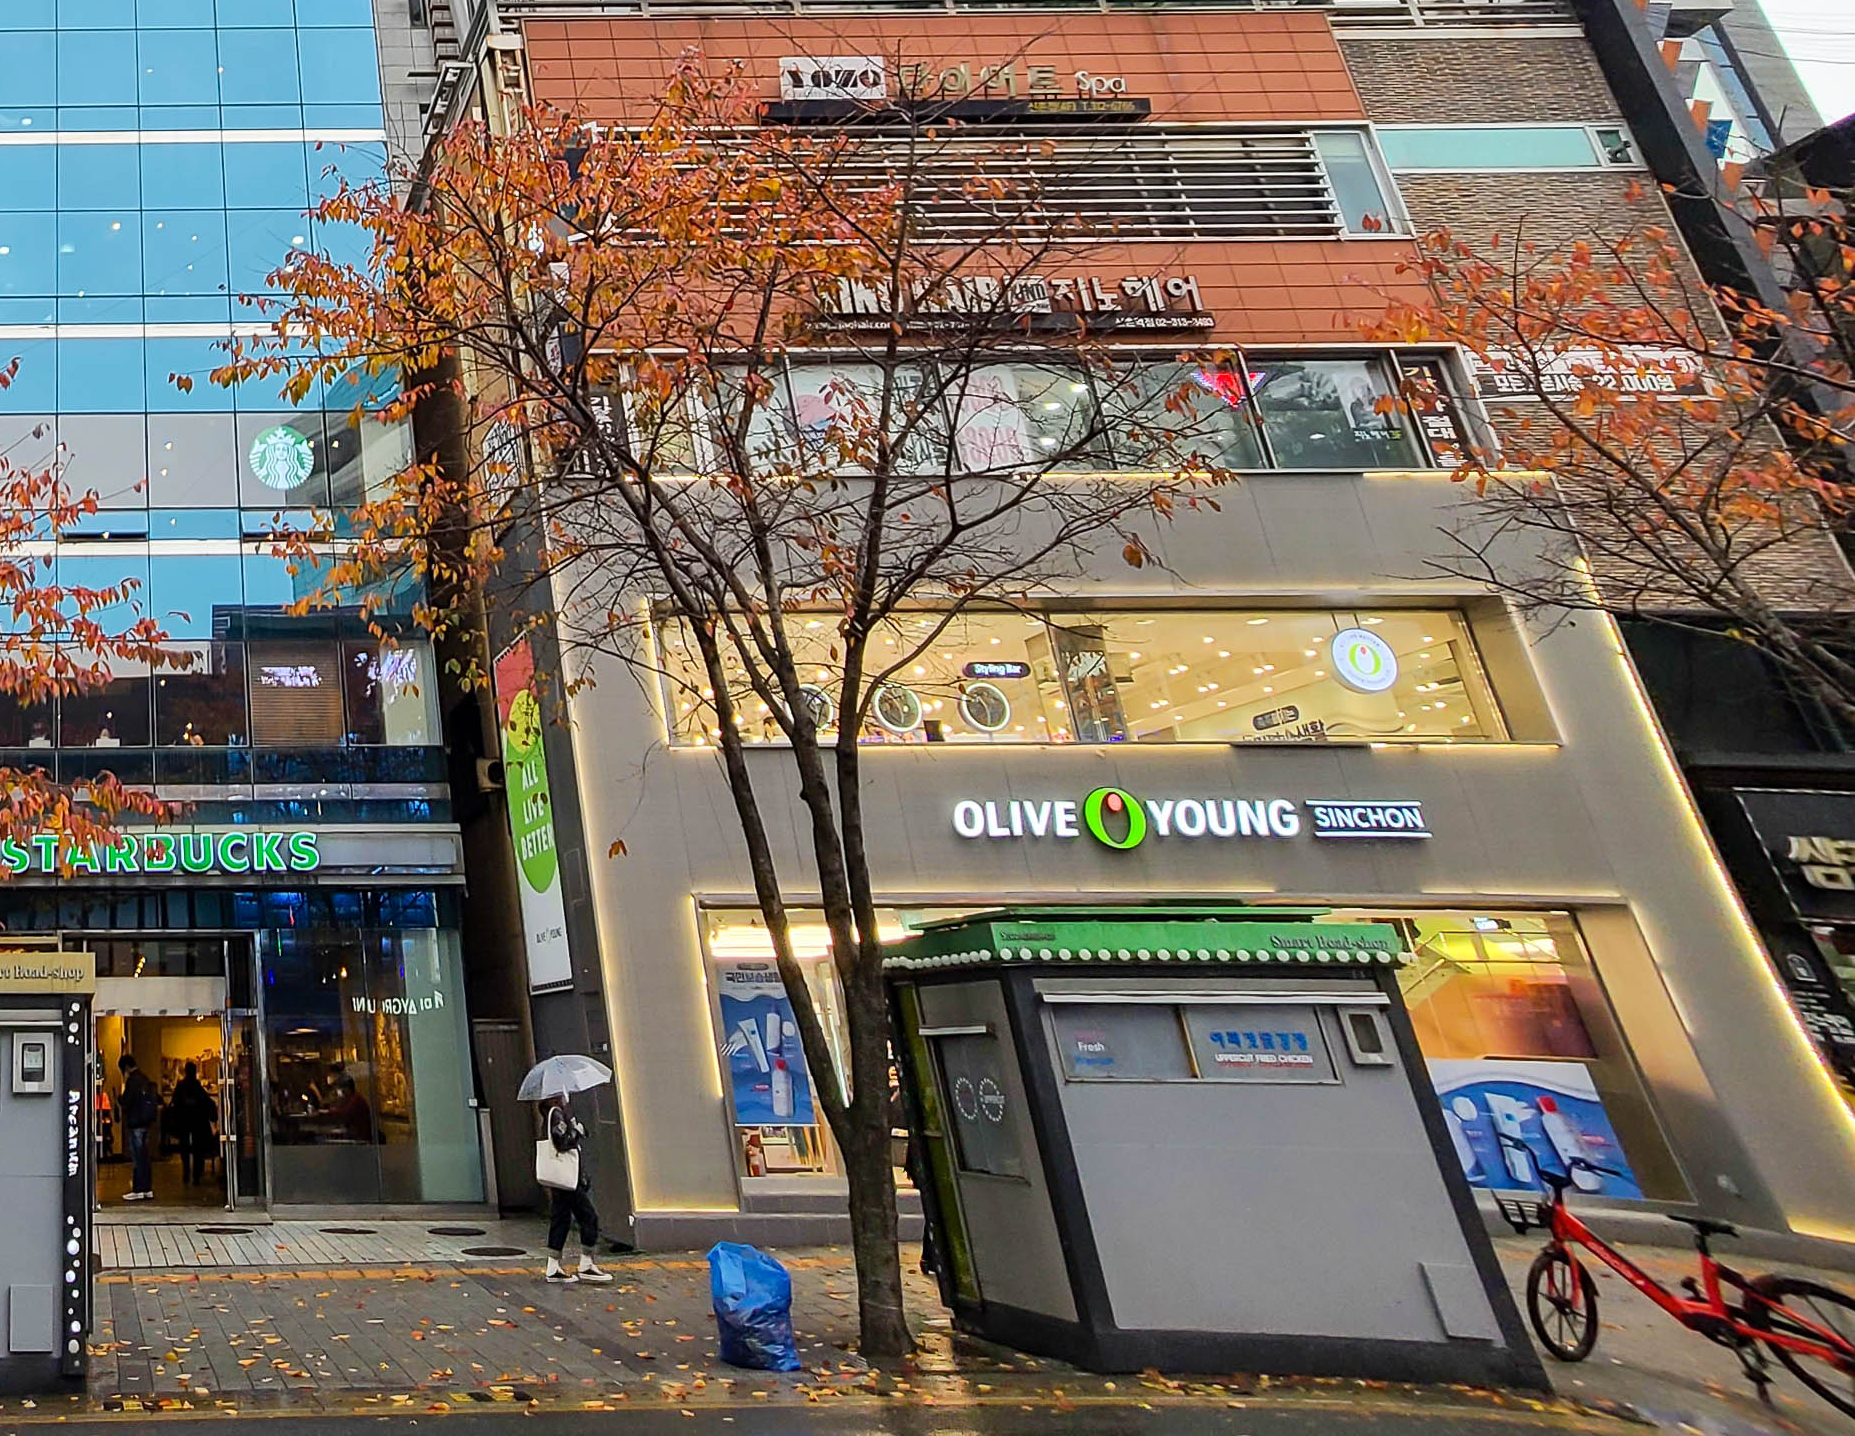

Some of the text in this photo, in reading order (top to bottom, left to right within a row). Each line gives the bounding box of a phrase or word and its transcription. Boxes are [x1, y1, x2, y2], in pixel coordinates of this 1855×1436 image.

[1074, 70, 1126, 97] Spa
[1050, 275, 1203, 312] 지노헤어
[522, 759, 539, 792] ALL
[953, 798, 1425, 838] OLIVE YOUNG SINCHON
[1, 831, 321, 874] STARBUCKS
[520, 821, 556, 861] BETTER
[1271, 934, 1314, 949] Smart
[14, 964, 84, 982] Road-shop
[1077, 1041, 1105, 1053] Fresh
